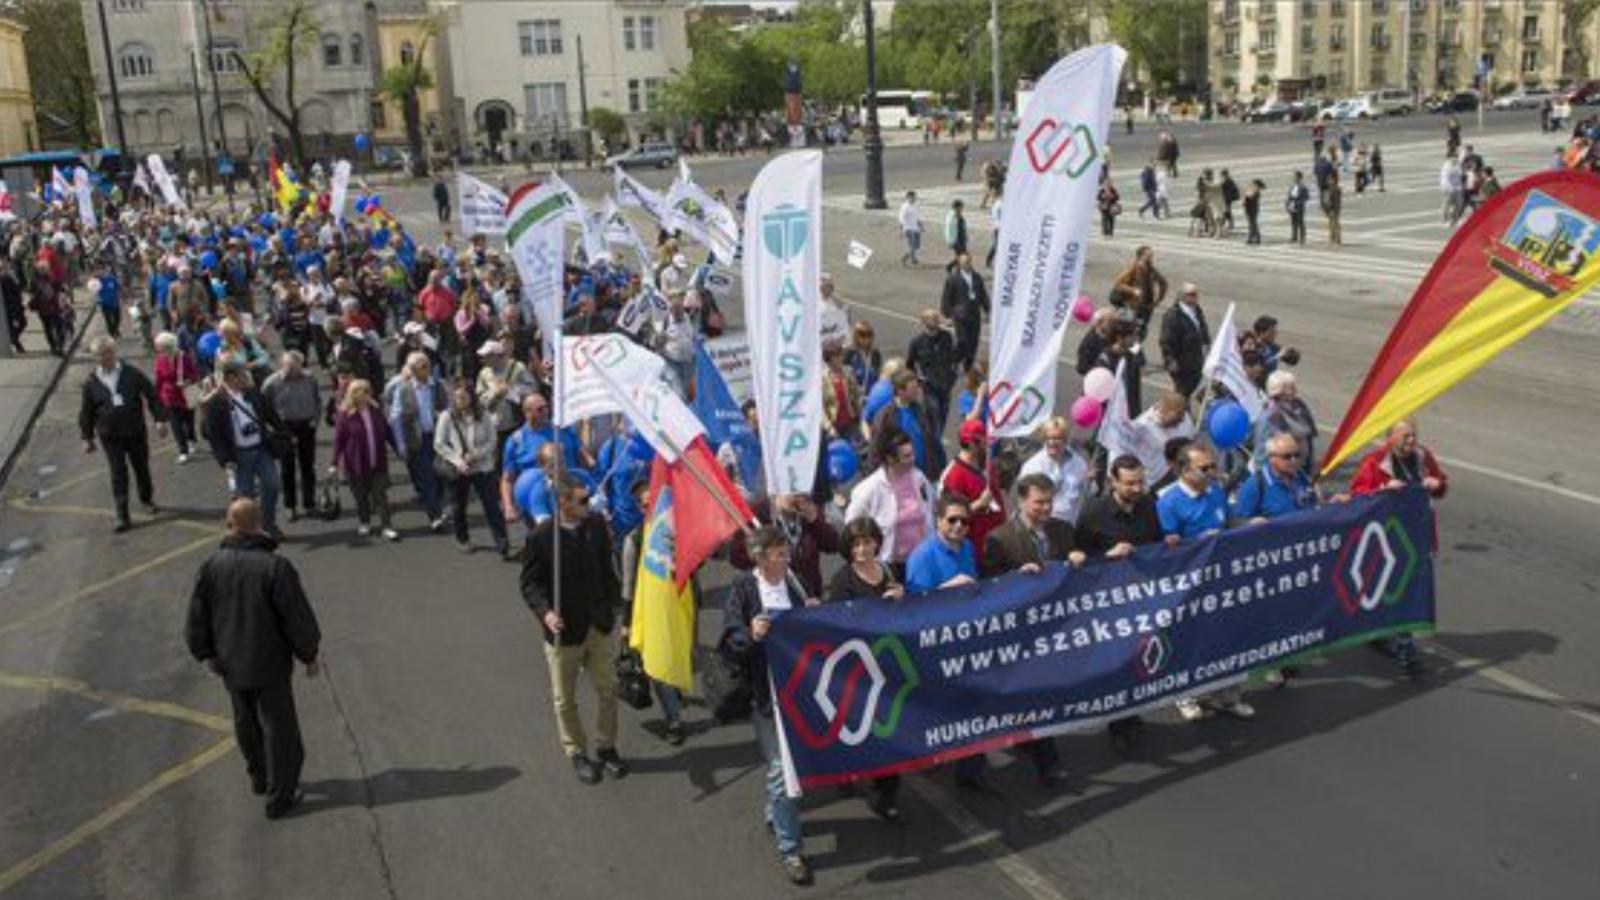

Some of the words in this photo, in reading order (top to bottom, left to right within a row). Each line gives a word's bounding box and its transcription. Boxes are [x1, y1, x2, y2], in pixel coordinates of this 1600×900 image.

[1001, 242, 1022, 307] MAGYAR
[1021, 213, 1055, 347] SZAKSZERVEZETI
[919, 612, 1017, 648] MAGYAR
[1026, 563, 1221, 624] SZAKSZERVEZETI
[1231, 534, 1342, 575] SZÖVETSÉG
[940, 564, 1321, 678] www.szakszervezet.net
[925, 707, 1054, 747] HUNGARIAN
[1063, 690, 1128, 717] TRADE
[1132, 671, 1189, 699] UNION
[1194, 628, 1326, 680] CONFEDERATION
